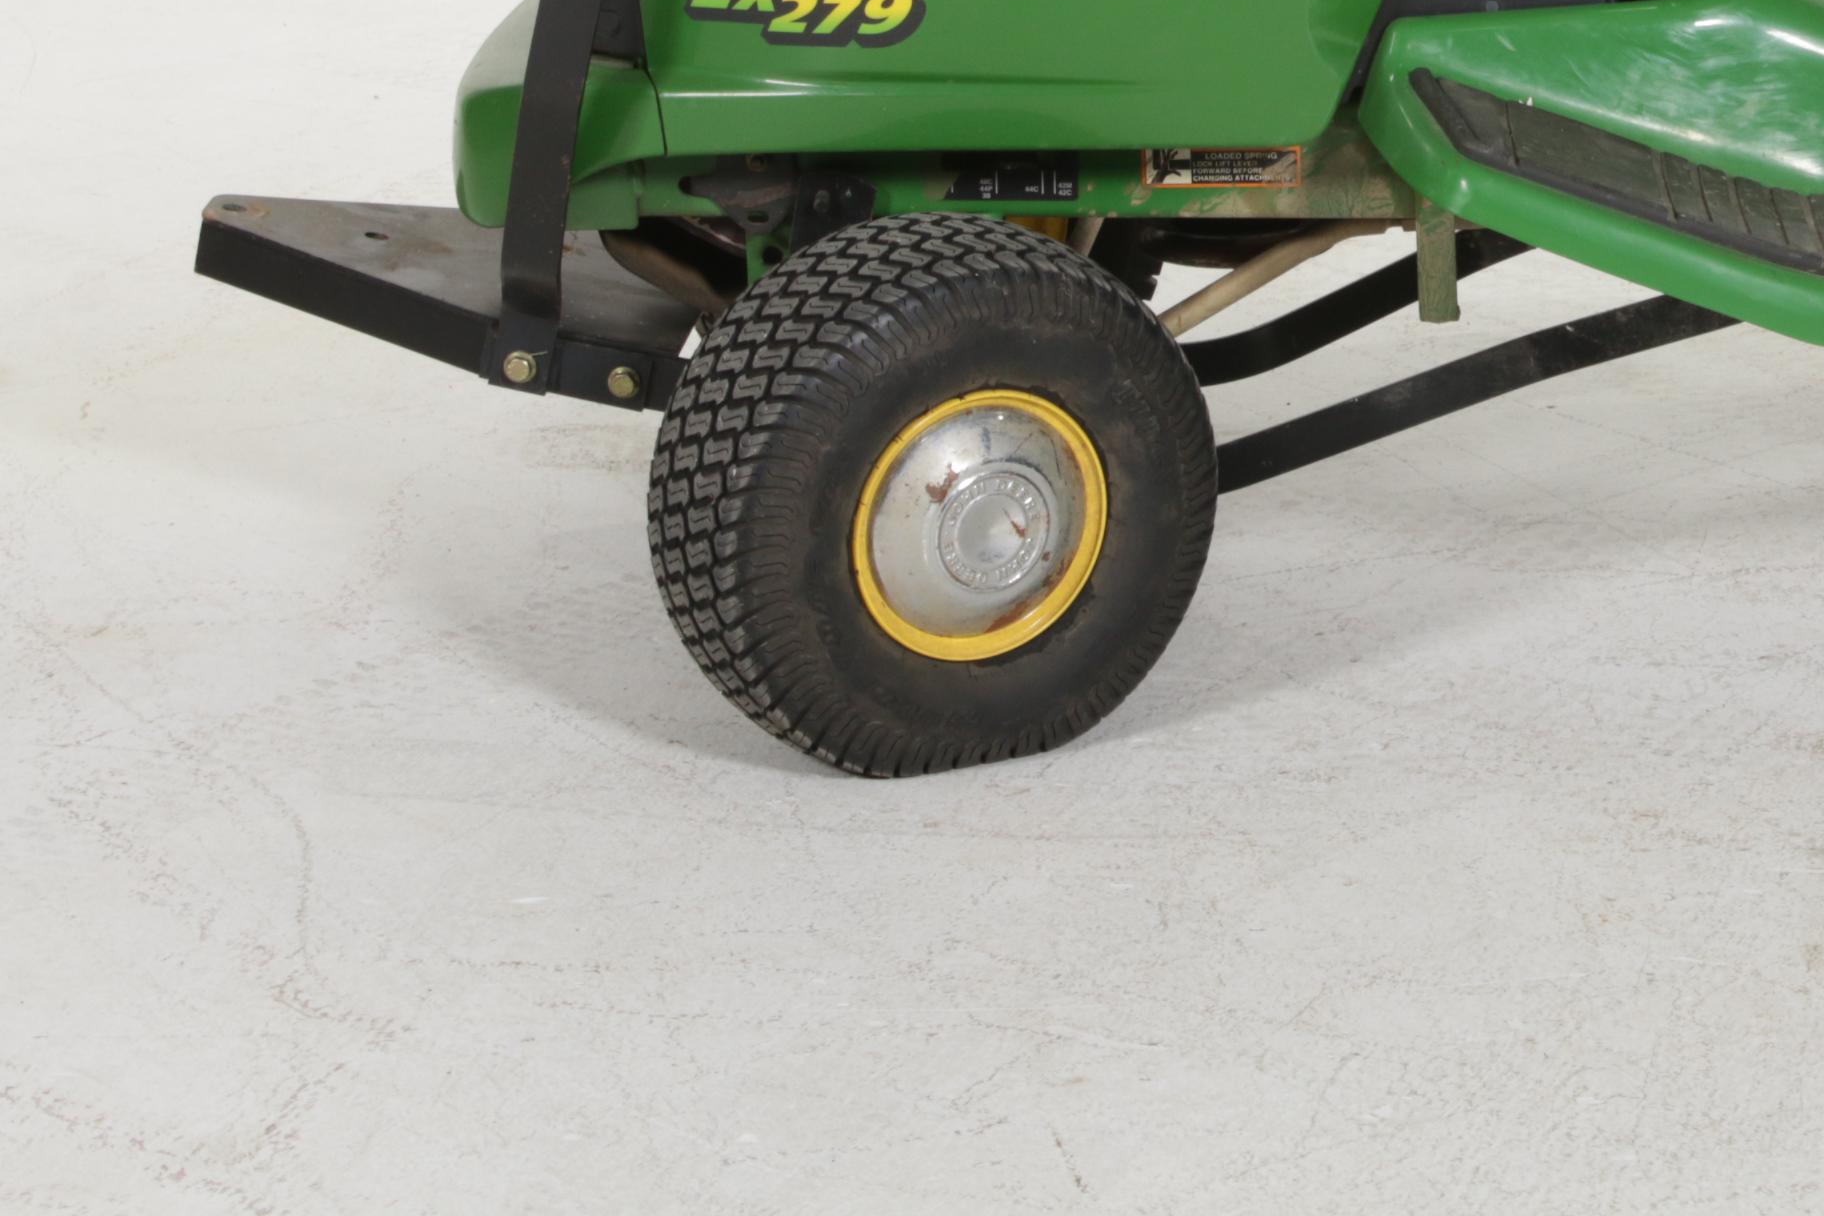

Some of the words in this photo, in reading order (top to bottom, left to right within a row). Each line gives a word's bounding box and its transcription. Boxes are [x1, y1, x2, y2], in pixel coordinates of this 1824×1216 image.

[1204, 151, 1243, 160] LOADED
[1192, 167, 1231, 175] FORWARD
[1232, 167, 1264, 175] BEFORE
[1192, 174, 1233, 183] CHANGING
